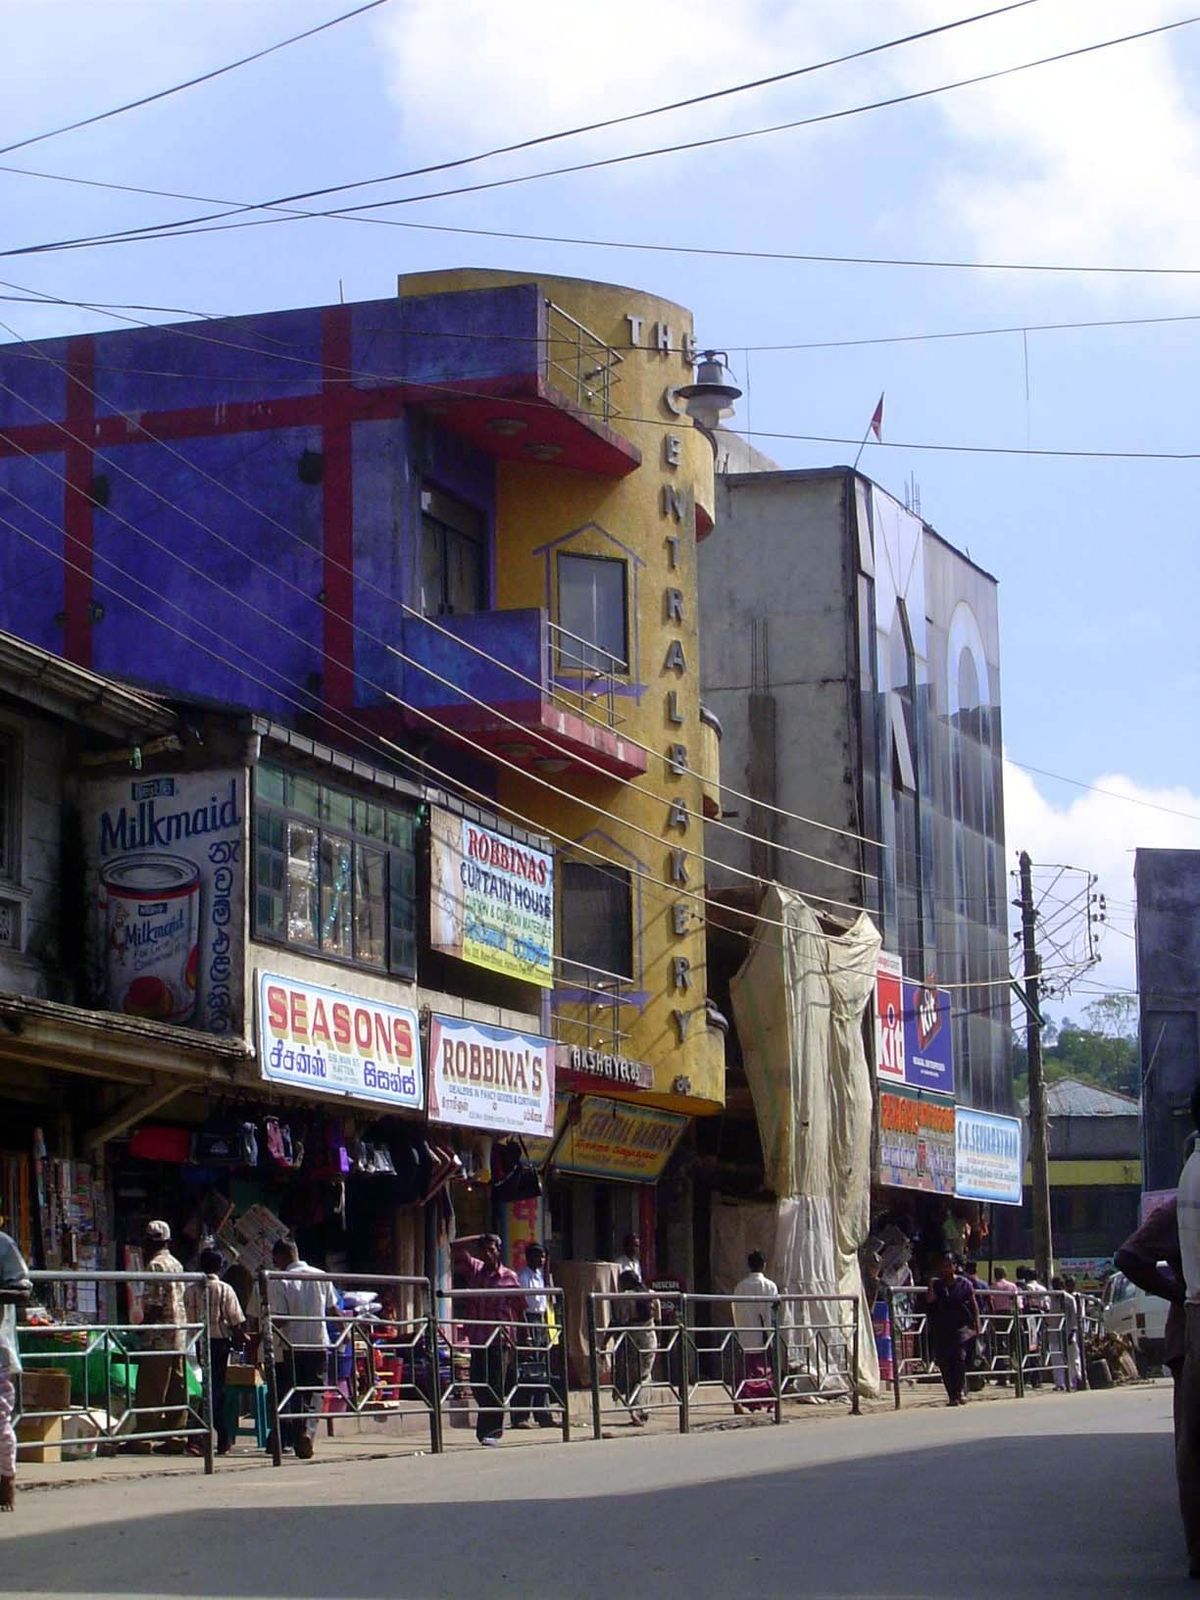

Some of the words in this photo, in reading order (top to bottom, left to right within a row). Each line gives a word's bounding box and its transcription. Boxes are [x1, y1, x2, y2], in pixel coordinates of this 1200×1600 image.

[624, 313, 697, 363] THE
[664, 384, 687, 724] CENTRAL
[100, 778, 241, 855] Milkmaid
[460, 862, 512, 903] CURTAIN
[513, 884, 551, 918] HOUSE
[468, 828, 548, 888] ROBBINAS
[669, 744, 692, 1044] BAKERY
[267, 985, 413, 1061] SEASONS
[442, 1038, 543, 1092] ROBBINA'S
